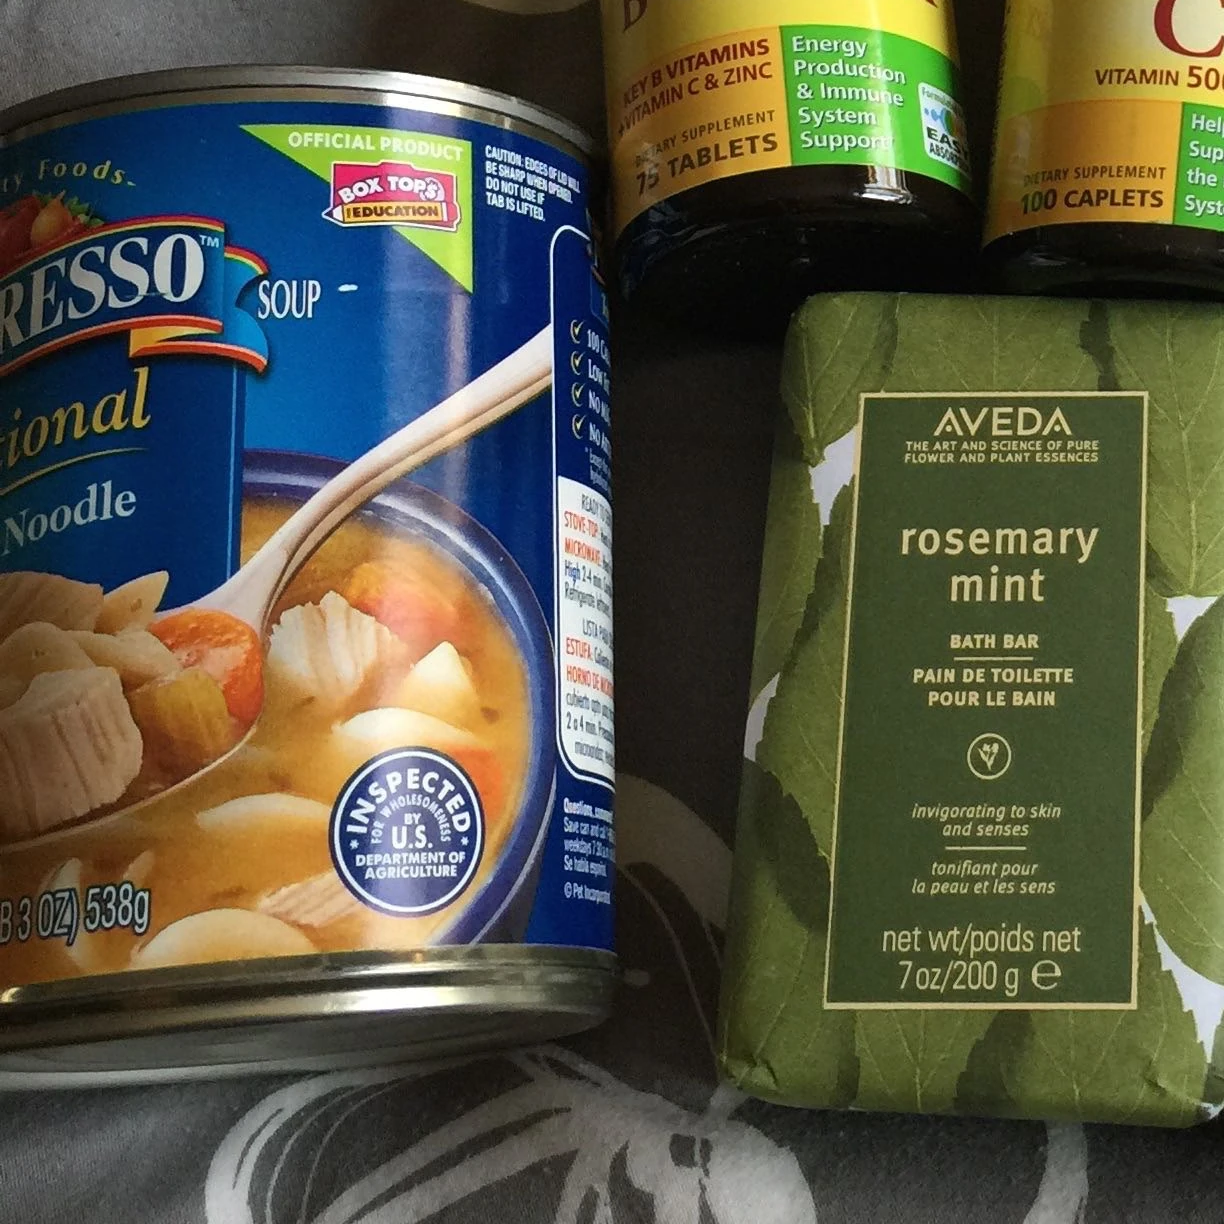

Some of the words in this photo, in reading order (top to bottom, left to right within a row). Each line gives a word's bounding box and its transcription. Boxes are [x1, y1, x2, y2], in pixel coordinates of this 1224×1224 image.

[665, 38, 770, 80] VITAMINS
[791, 35, 868, 59] Energy
[723, 61, 773, 87] ZINC
[793, 58, 907, 85] Production
[1095, 68, 1180, 87] VITAMIN
[820, 82, 905, 107] Immune
[681, 110, 775, 143] SUPPLEMENT
[798, 106, 878, 128] System
[287, 131, 376, 152] OFFICIAL
[379, 135, 465, 162] PRODUCT
[800, 130, 895, 152] Support
[667, 132, 778, 179] TABLETS
[1073, 164, 1167, 181] SUPPLEMENT
[1186, 167, 1218, 187] the
[337, 176, 385, 204] BOX
[386, 175, 441, 202] TOPS
[1020, 187, 1058, 215] 100
[1063, 188, 1164, 209] CAPLETS
[352, 205, 440, 219] EDUCATION
[257, 279, 322, 320] SOUP
[933, 406, 1072, 437] AVEDA
[904, 452, 955, 464] FLOWER
[960, 452, 986, 464] AND
[990, 452, 1031, 464] PLANT
[1035, 452, 1099, 464] ESSENCES
[905, 440, 929, 452] THE
[933, 440, 957, 452] ART
[960, 440, 987, 452] AND
[991, 440, 1042, 452] SCIENCE
[1046, 440, 1063, 452] OF
[1067, 440, 1100, 452] PURE
[0, 479, 137, 557] Noodle
[901, 526, 1100, 564] rosemary
[950, 564, 1046, 603] mint
[950, 634, 996, 649] BATH
[1002, 634, 1040, 649] BAR
[912, 667, 955, 684] PAIN
[962, 667, 984, 684] DE
[991, 667, 1075, 684] TOILETTE
[928, 691, 980, 707] POUR
[986, 691, 1006, 707] LE
[1012, 691, 1056, 707] BAIN
[345, 767, 472, 835] INSPECTED
[911, 802, 1006, 822] invigorating
[1010, 804, 1026, 819] to
[1030, 803, 1062, 819] skin
[379, 793, 452, 843] WHOLESOMENESS
[942, 821, 972, 837] and
[976, 823, 1030, 837] senses
[391, 824, 434, 850] U.S.
[355, 851, 447, 868] DEPARTMENT
[364, 864, 458, 880] AGRICULTURE
[930, 859, 998, 877] tonifiant
[1001, 862, 1039, 880] pour
[929, 881, 969, 897] peau
[973, 880, 990, 895] et
[992, 879, 1015, 895] les
[1019, 881, 1057, 895] sens
[84, 881, 151, 935] 538g
[882, 927, 921, 954] net
[928, 923, 1035, 958] wt/poids
[1041, 927, 1082, 954] net
[898, 960, 913, 991] 7
[914, 959, 998, 995] oz/200
[1004, 965, 1020, 997] g
